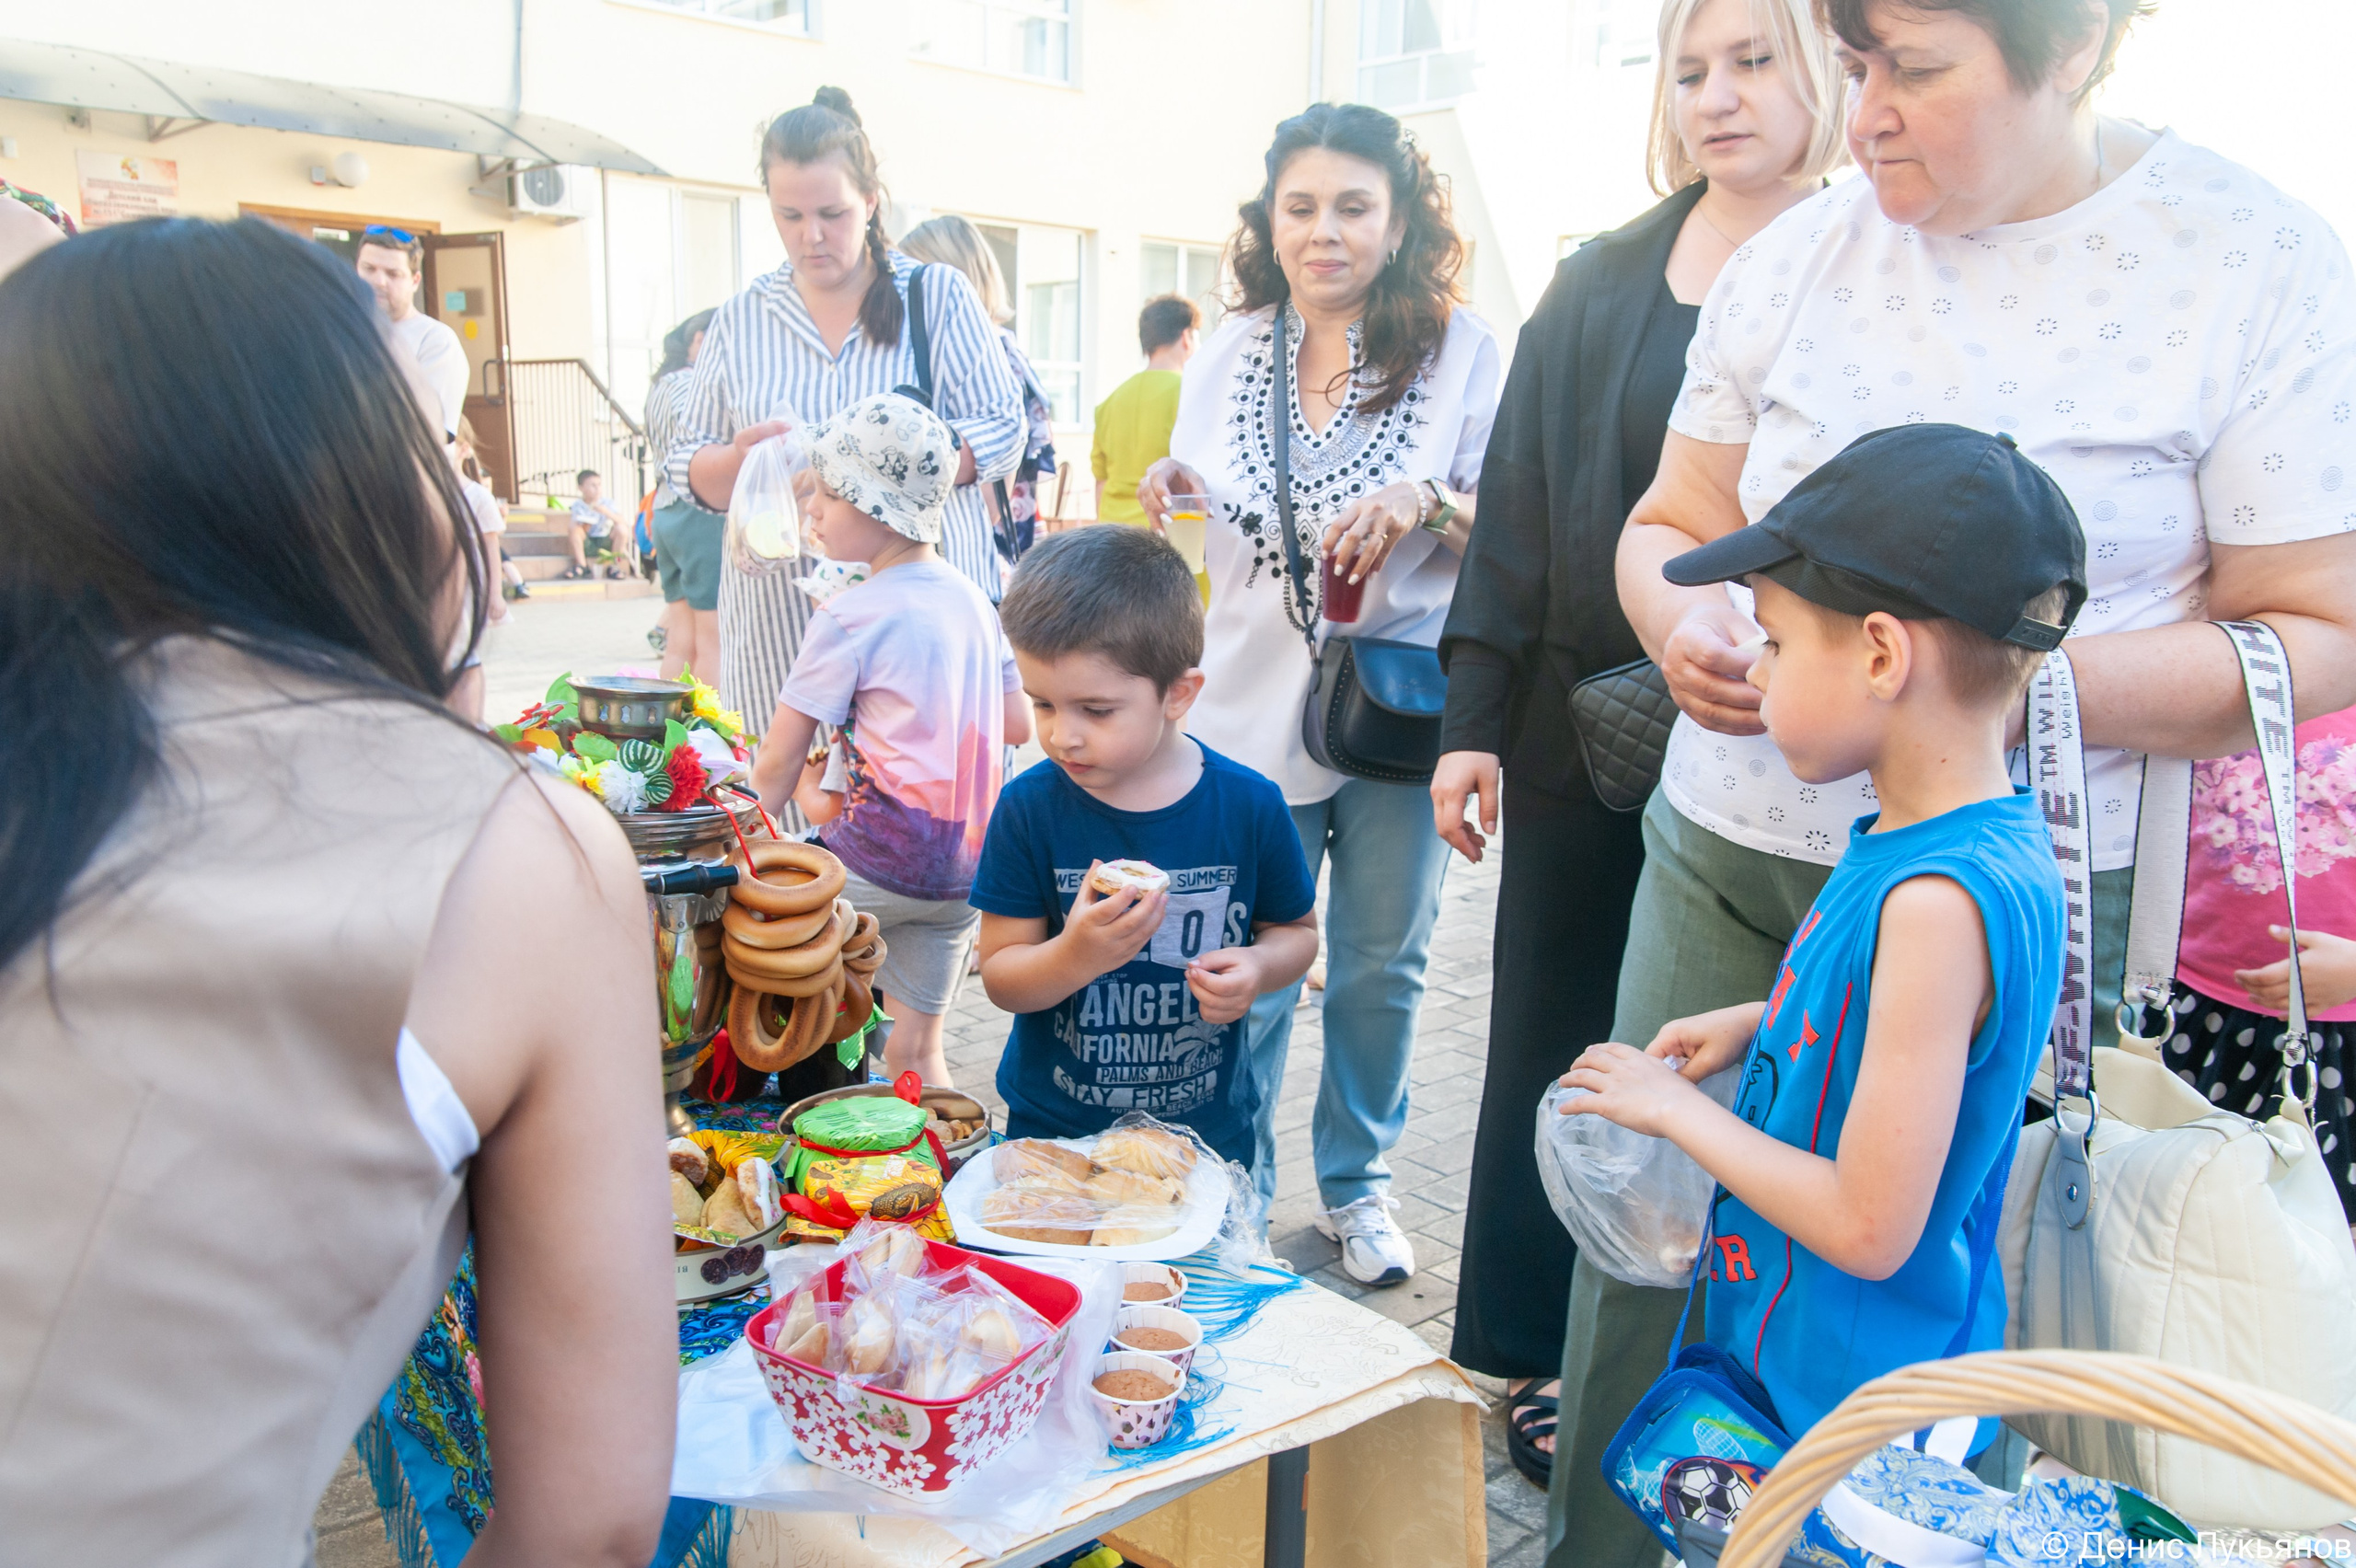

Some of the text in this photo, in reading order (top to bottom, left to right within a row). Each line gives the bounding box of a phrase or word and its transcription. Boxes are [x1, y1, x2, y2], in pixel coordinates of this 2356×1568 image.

[1177, 868, 1237, 888] SUMMER
[1054, 1011, 1175, 1064] CAIFORNIA
[1101, 1067, 1149, 1083] PALMS
[1155, 1065, 1184, 1080] AND
[1060, 1074, 1207, 1107] STAY FRESH
